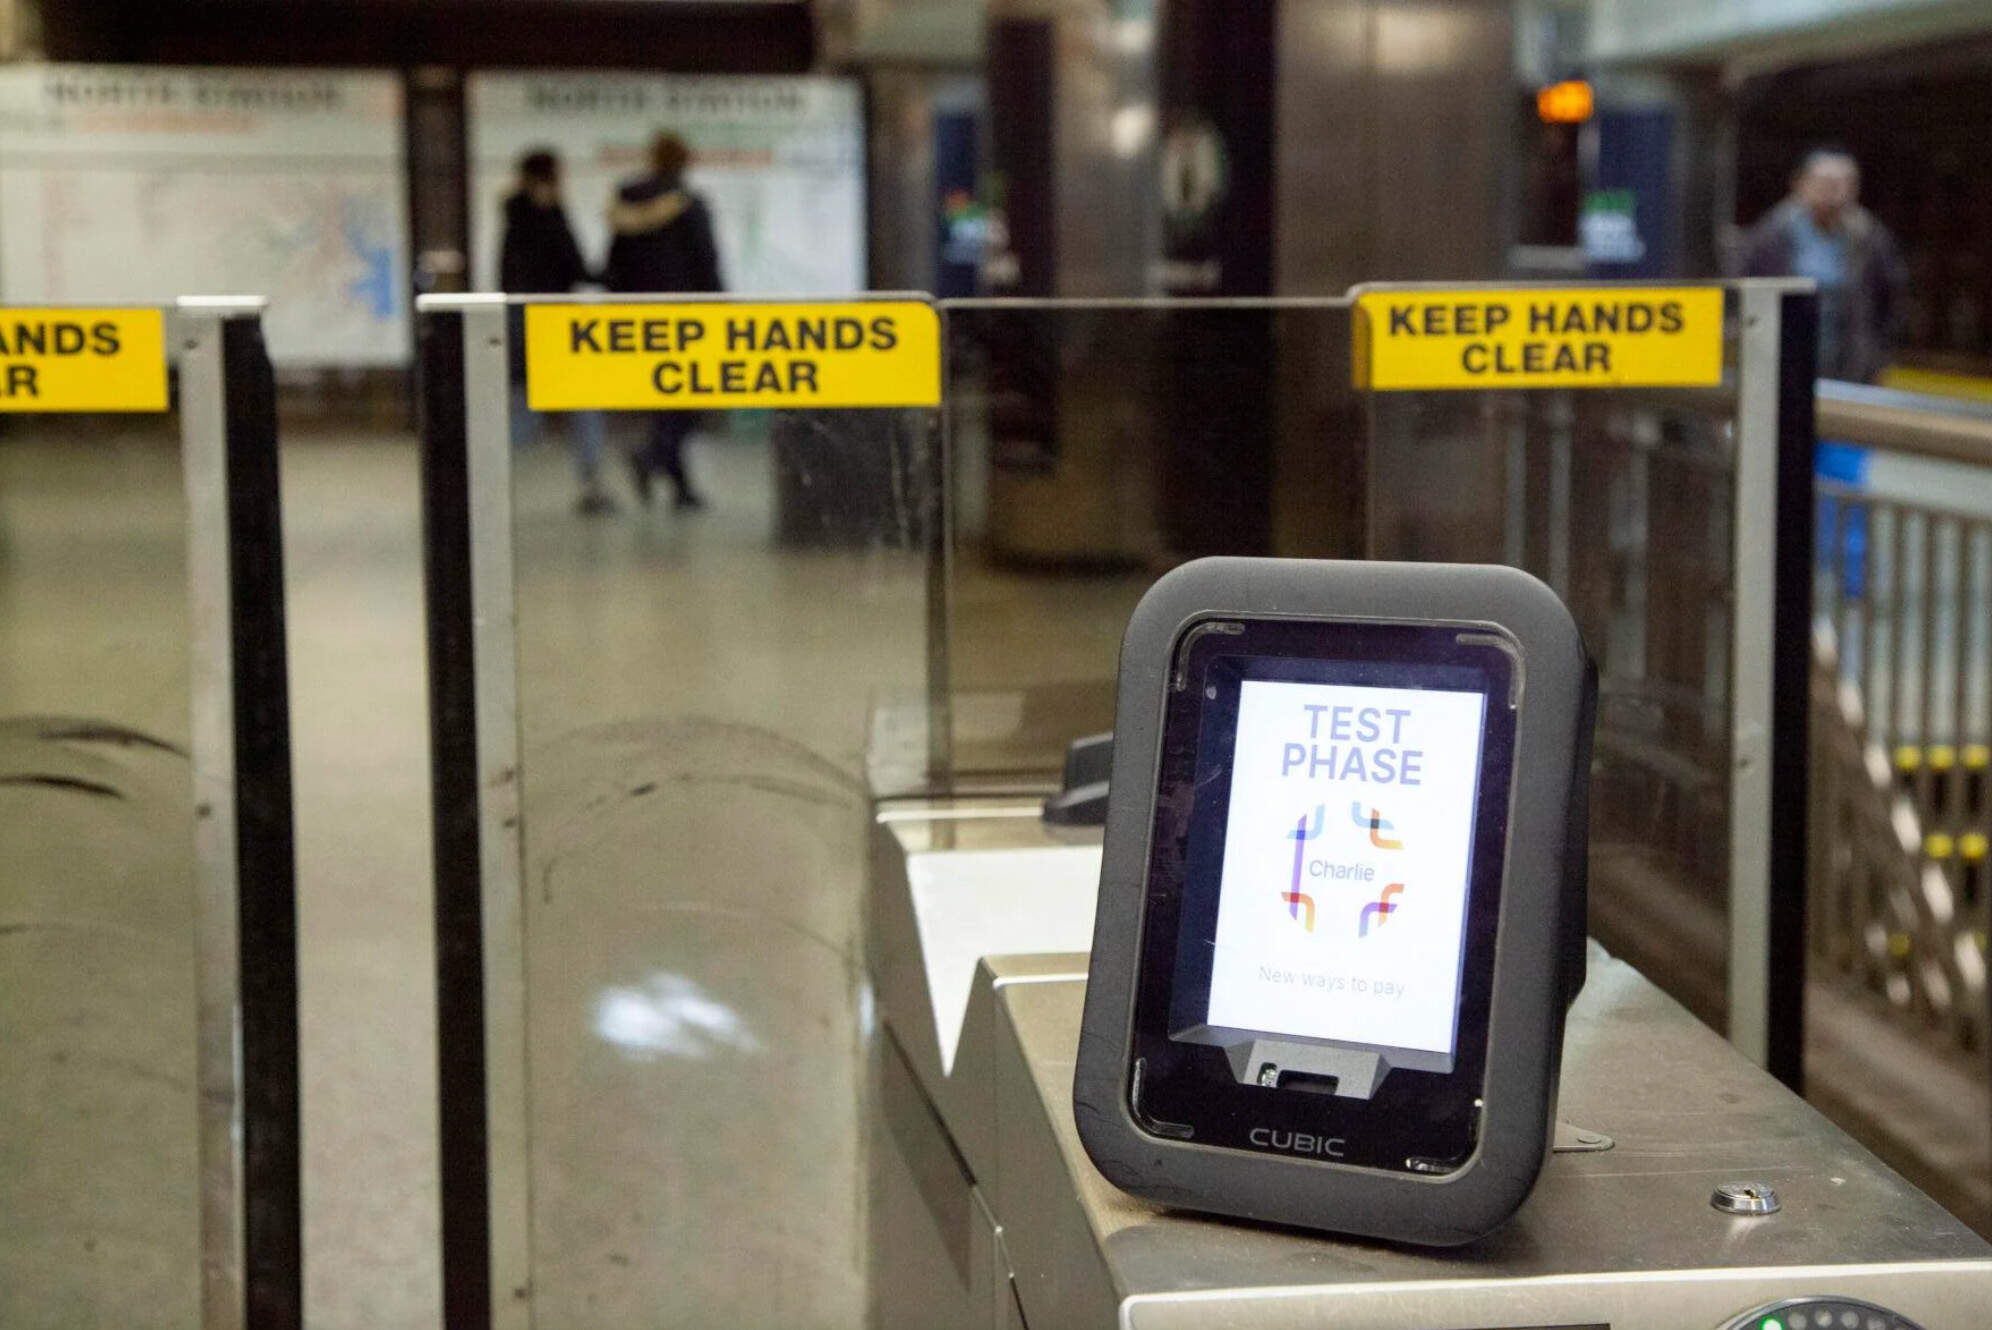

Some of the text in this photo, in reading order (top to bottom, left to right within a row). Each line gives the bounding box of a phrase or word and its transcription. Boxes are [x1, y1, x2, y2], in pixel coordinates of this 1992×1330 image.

[570, 318, 897, 353] KEEP HANDS
[1390, 302, 1683, 336] KEEP HANDS
[1462, 343, 1610, 374] CLEAR
[0, 365, 39, 397] R
[653, 361, 818, 395] CLEAR
[1304, 704, 1411, 743] TEST
[1282, 742, 1423, 786] PHASE
[1308, 859, 1375, 882] Charlie
[1258, 965, 1406, 1001] New ways to pay
[1250, 1127, 1346, 1157] CUBIC
